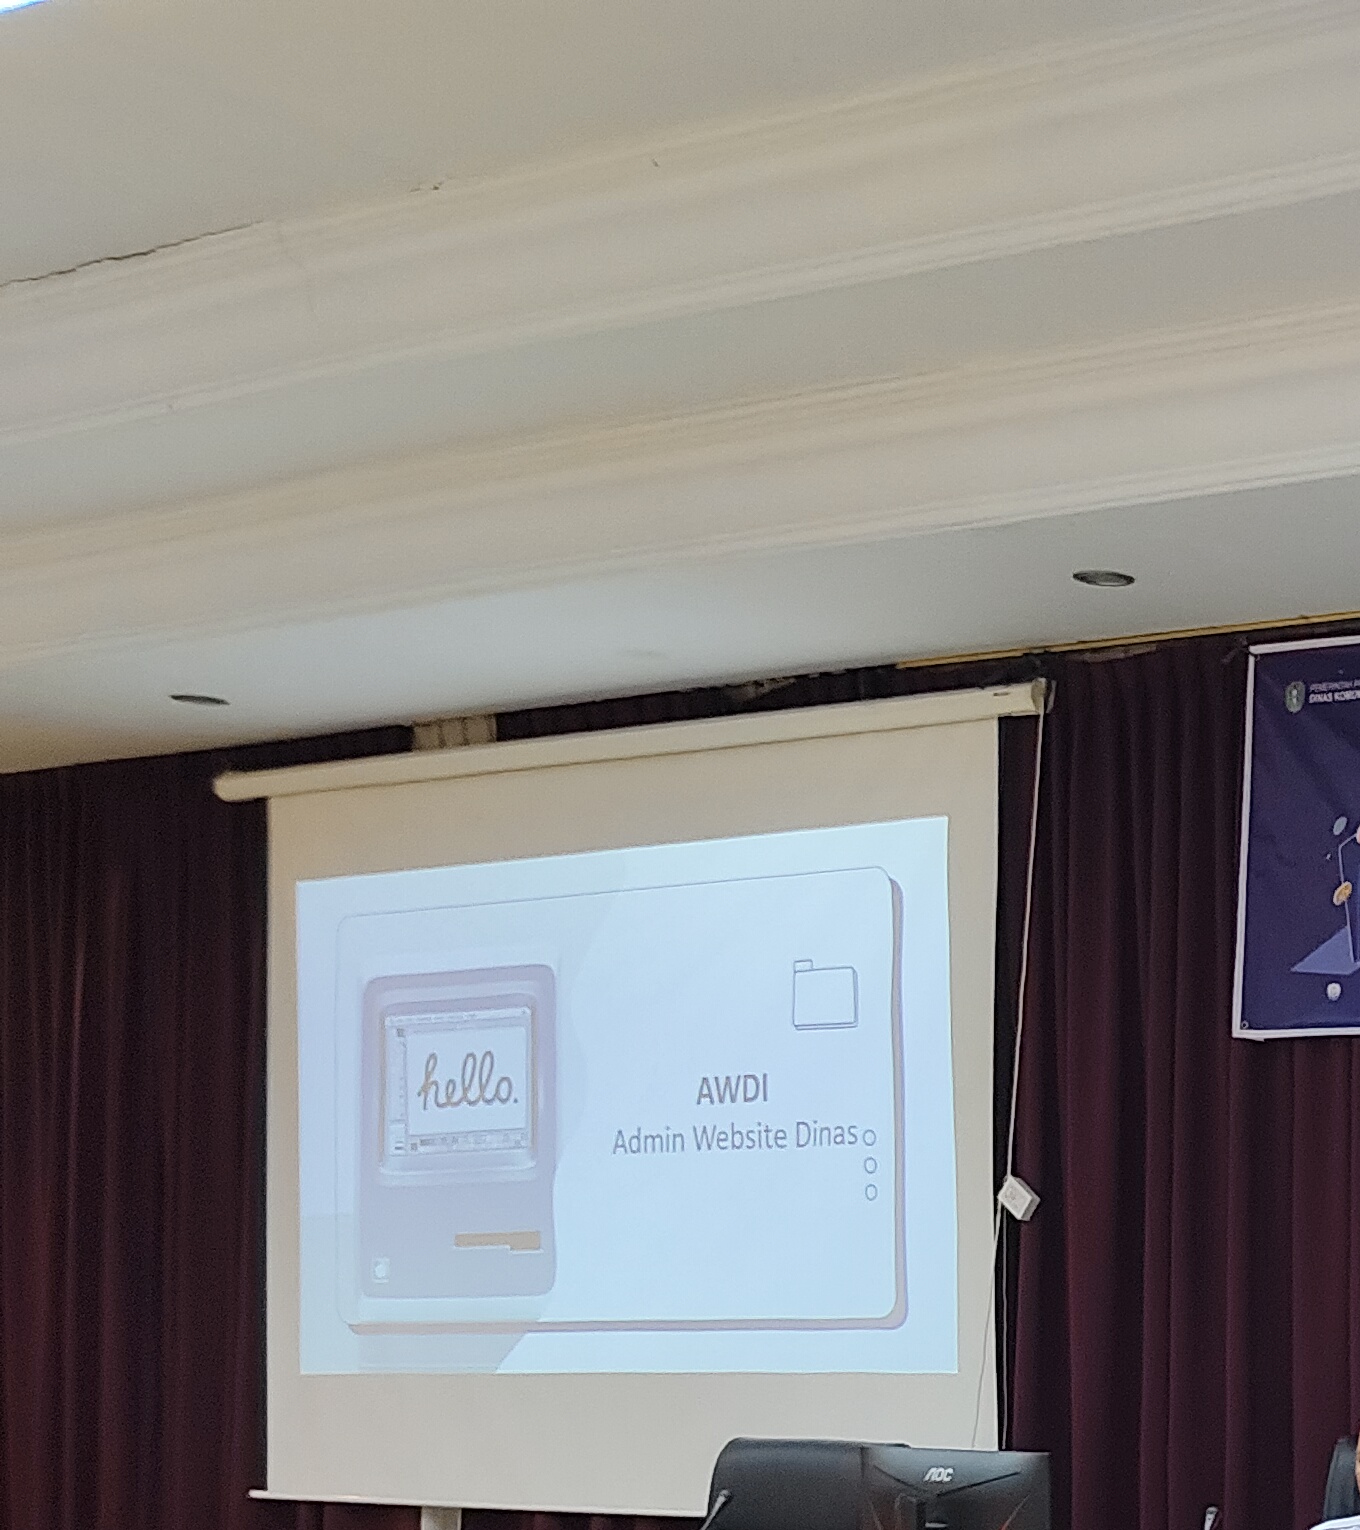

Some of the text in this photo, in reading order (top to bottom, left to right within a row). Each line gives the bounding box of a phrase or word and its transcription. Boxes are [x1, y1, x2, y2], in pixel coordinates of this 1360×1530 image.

[416, 1050, 519, 1111] hello.
[696, 1072, 769, 1106] AWDI
[612, 1119, 859, 1155] Admin Website Dinas
[922, 1466, 954, 1482] AOC
